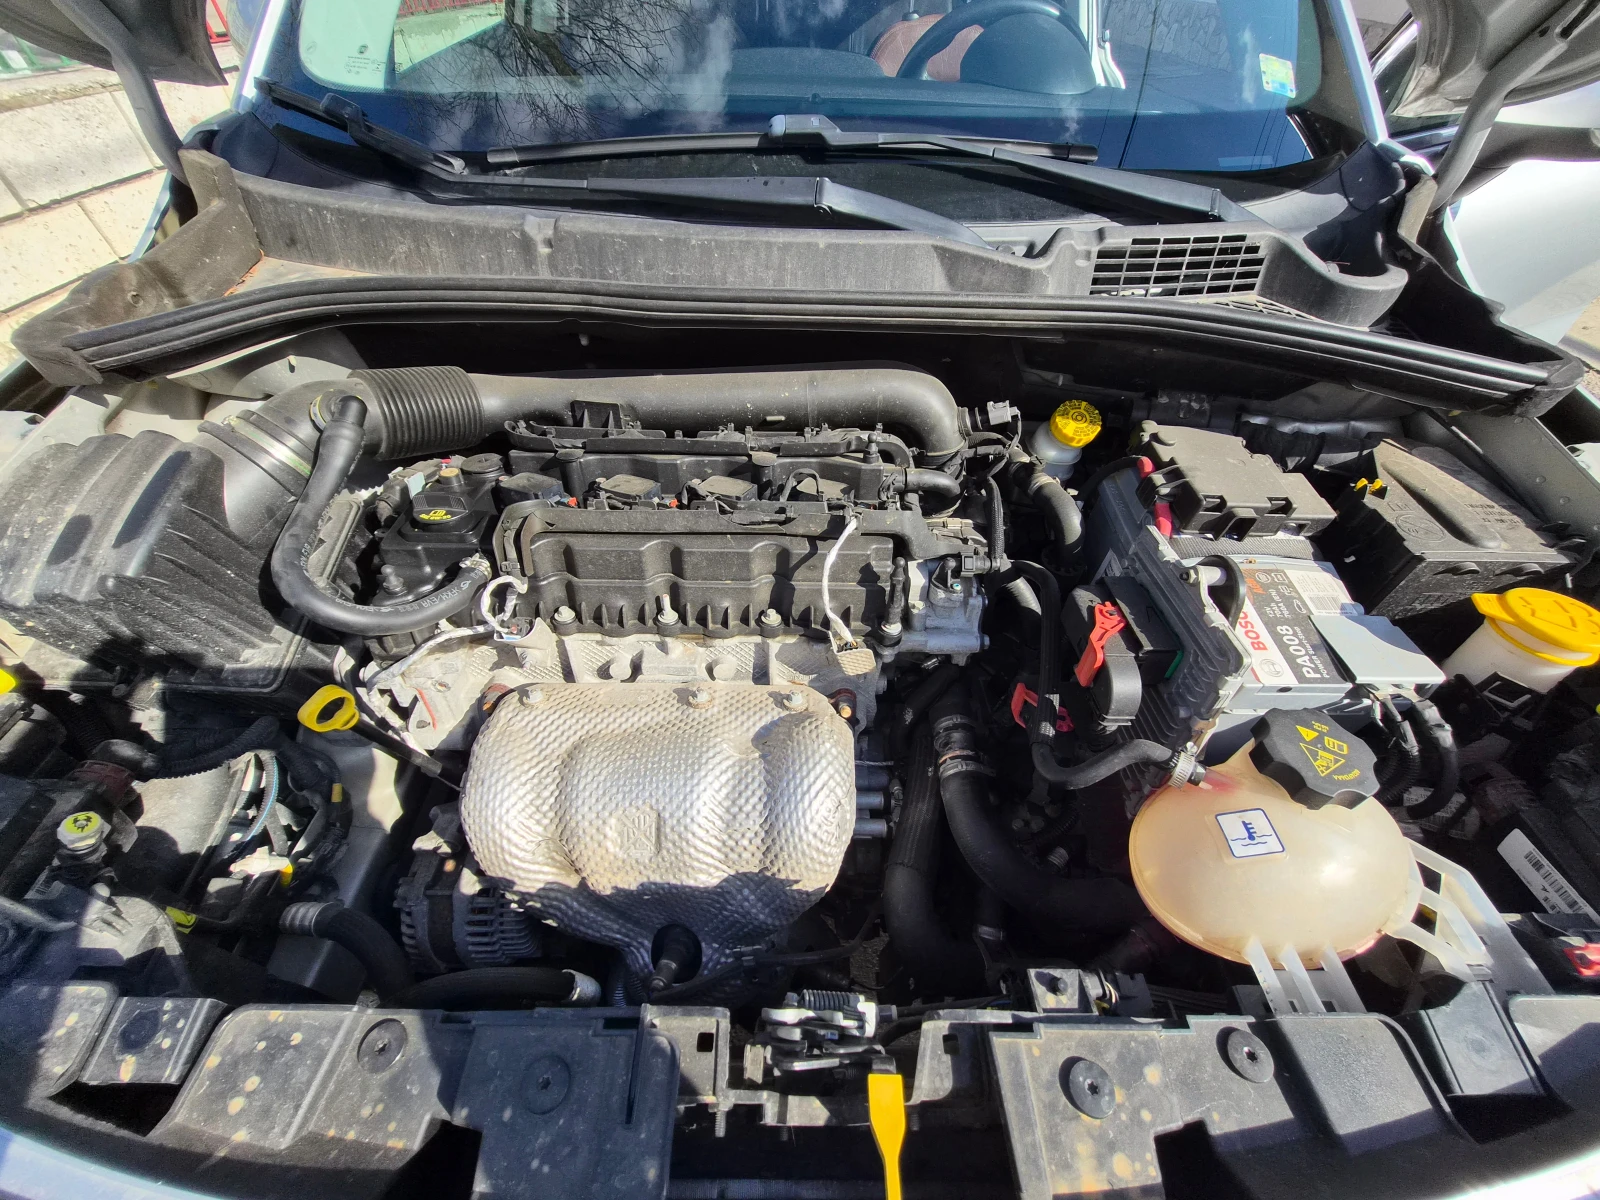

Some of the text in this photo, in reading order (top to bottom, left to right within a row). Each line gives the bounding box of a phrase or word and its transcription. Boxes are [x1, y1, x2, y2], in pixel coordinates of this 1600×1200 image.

[1264, 606, 1275, 618] 12V
[1239, 611, 1268, 651] BOSC
[1277, 625, 1322, 678] PA008
[1311, 655, 1331, 678] POWER
